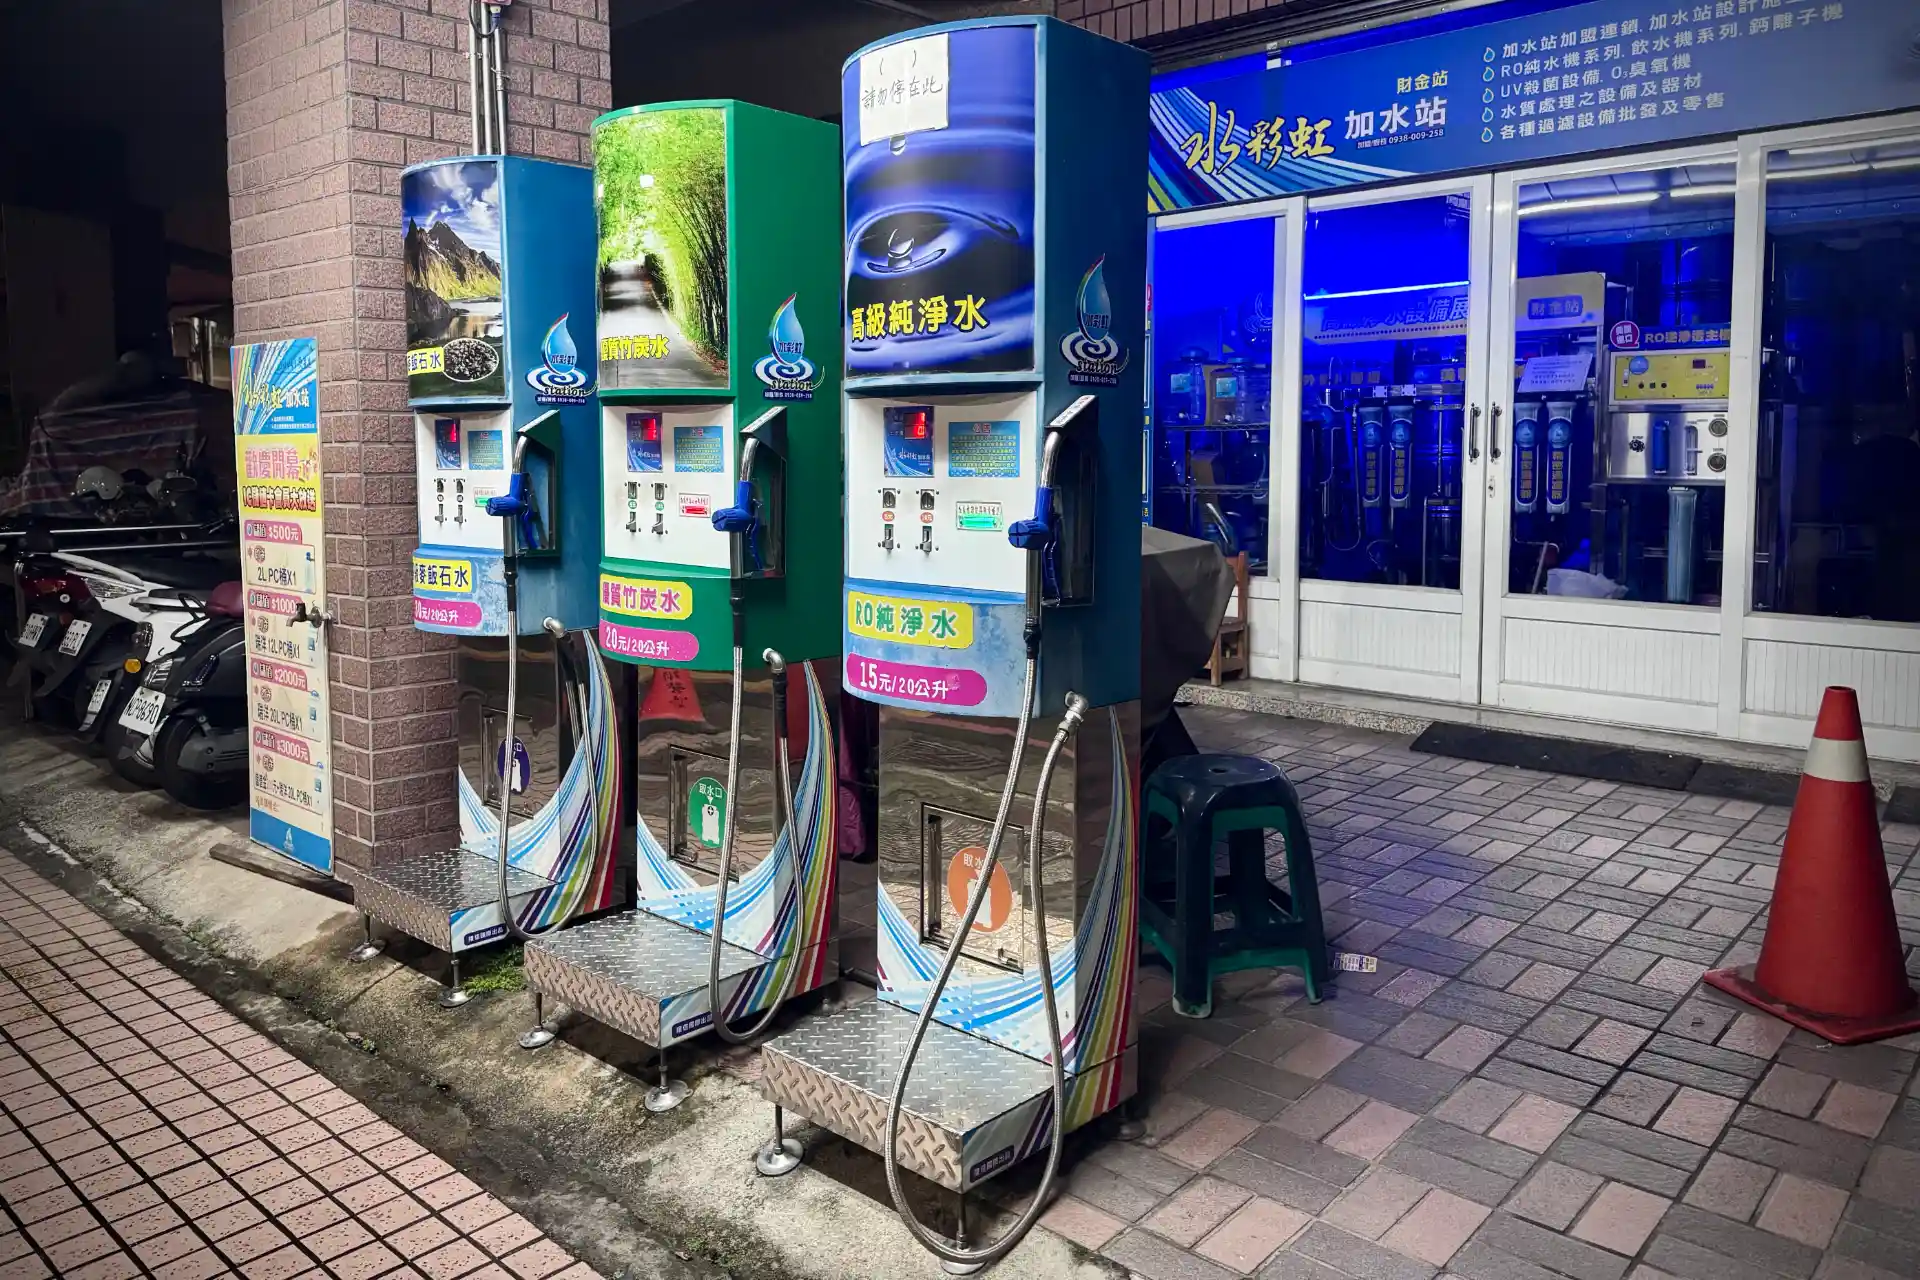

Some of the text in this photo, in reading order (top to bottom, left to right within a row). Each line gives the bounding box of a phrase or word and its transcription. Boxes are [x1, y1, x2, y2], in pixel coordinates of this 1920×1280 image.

[1649, 0, 1805, 31] 加水站設計施
[862, 75, 944, 110] 請勿停在此
[1397, 70, 1449, 94] 財金站
[1501, 73, 1704, 119] 水質處理之設備及器材
[1345, 96, 1449, 140] 加水站
[1500, 92, 1726, 140] 各種過濾設備批發及零售
[1180, 101, 1335, 175] 水彩虹
[1388, 129, 1444, 144] 0938-009-258
[851, 294, 988, 341] 高級純淨水
[1077, 358, 1118, 375] station
[543, 385, 585, 396] station
[771, 378, 812, 390] station
[268, 525, 299, 541] $500元
[258, 567, 267, 582] 2L
[271, 598, 298, 614] $1000
[856, 600, 957, 639] RO純淨水
[605, 626, 669, 656] 20元/20公升
[274, 667, 306, 689] $2000元
[860, 661, 949, 699] 15元/20公升
[699, 782, 723, 799] 取水口
[964, 853, 983, 869] 取水
